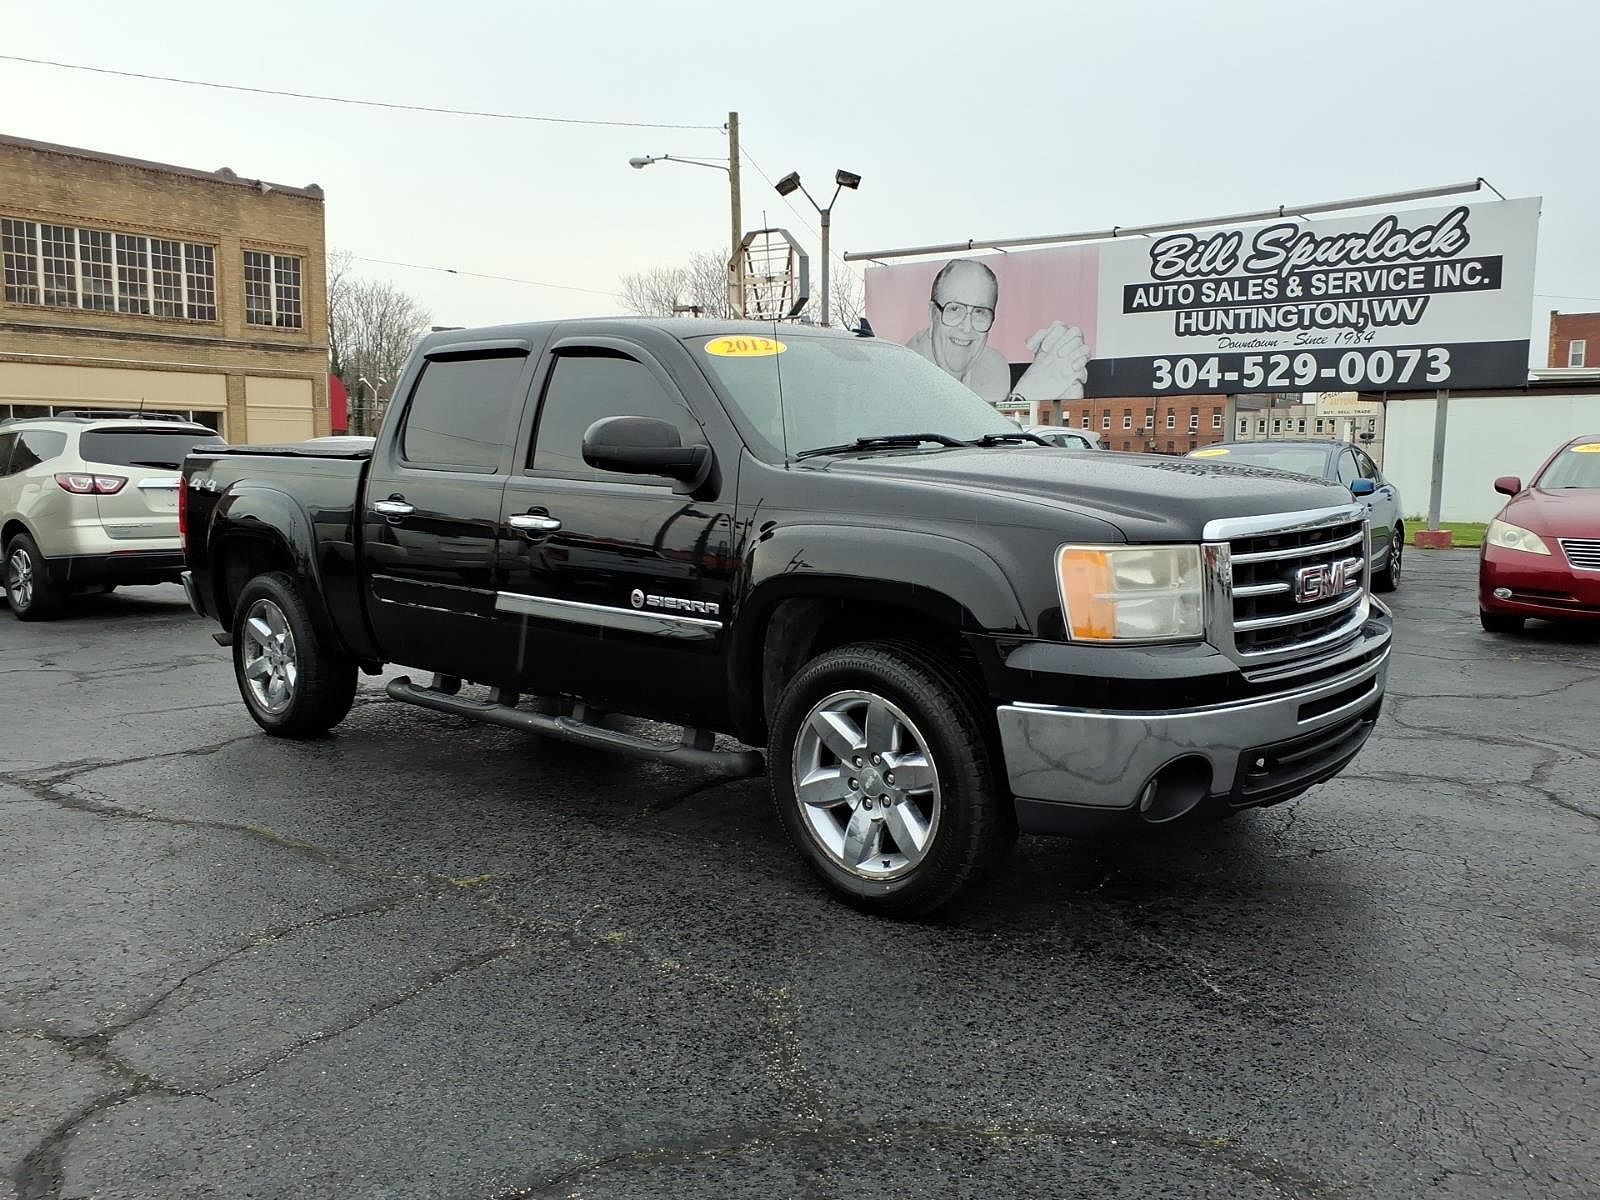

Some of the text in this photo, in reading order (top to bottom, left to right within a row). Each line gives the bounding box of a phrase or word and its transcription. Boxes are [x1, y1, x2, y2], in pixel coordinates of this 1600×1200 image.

[1150, 206, 1470, 281] Bill Spurlock
[1132, 261, 1490, 308] AUTO SALES & SERVICE INC.
[1177, 297, 1427, 334] HUNTINGTON, WV
[722, 340, 773, 353] 2012
[1217, 336, 1279, 349] Downtown
[1293, 332, 1328, 346] Since
[1334, 330, 1376, 345] 1984
[1152, 348, 1451, 390] 304-529-0073
[1295, 557, 1357, 603] GMC
[646, 594, 719, 615] SIERRA
